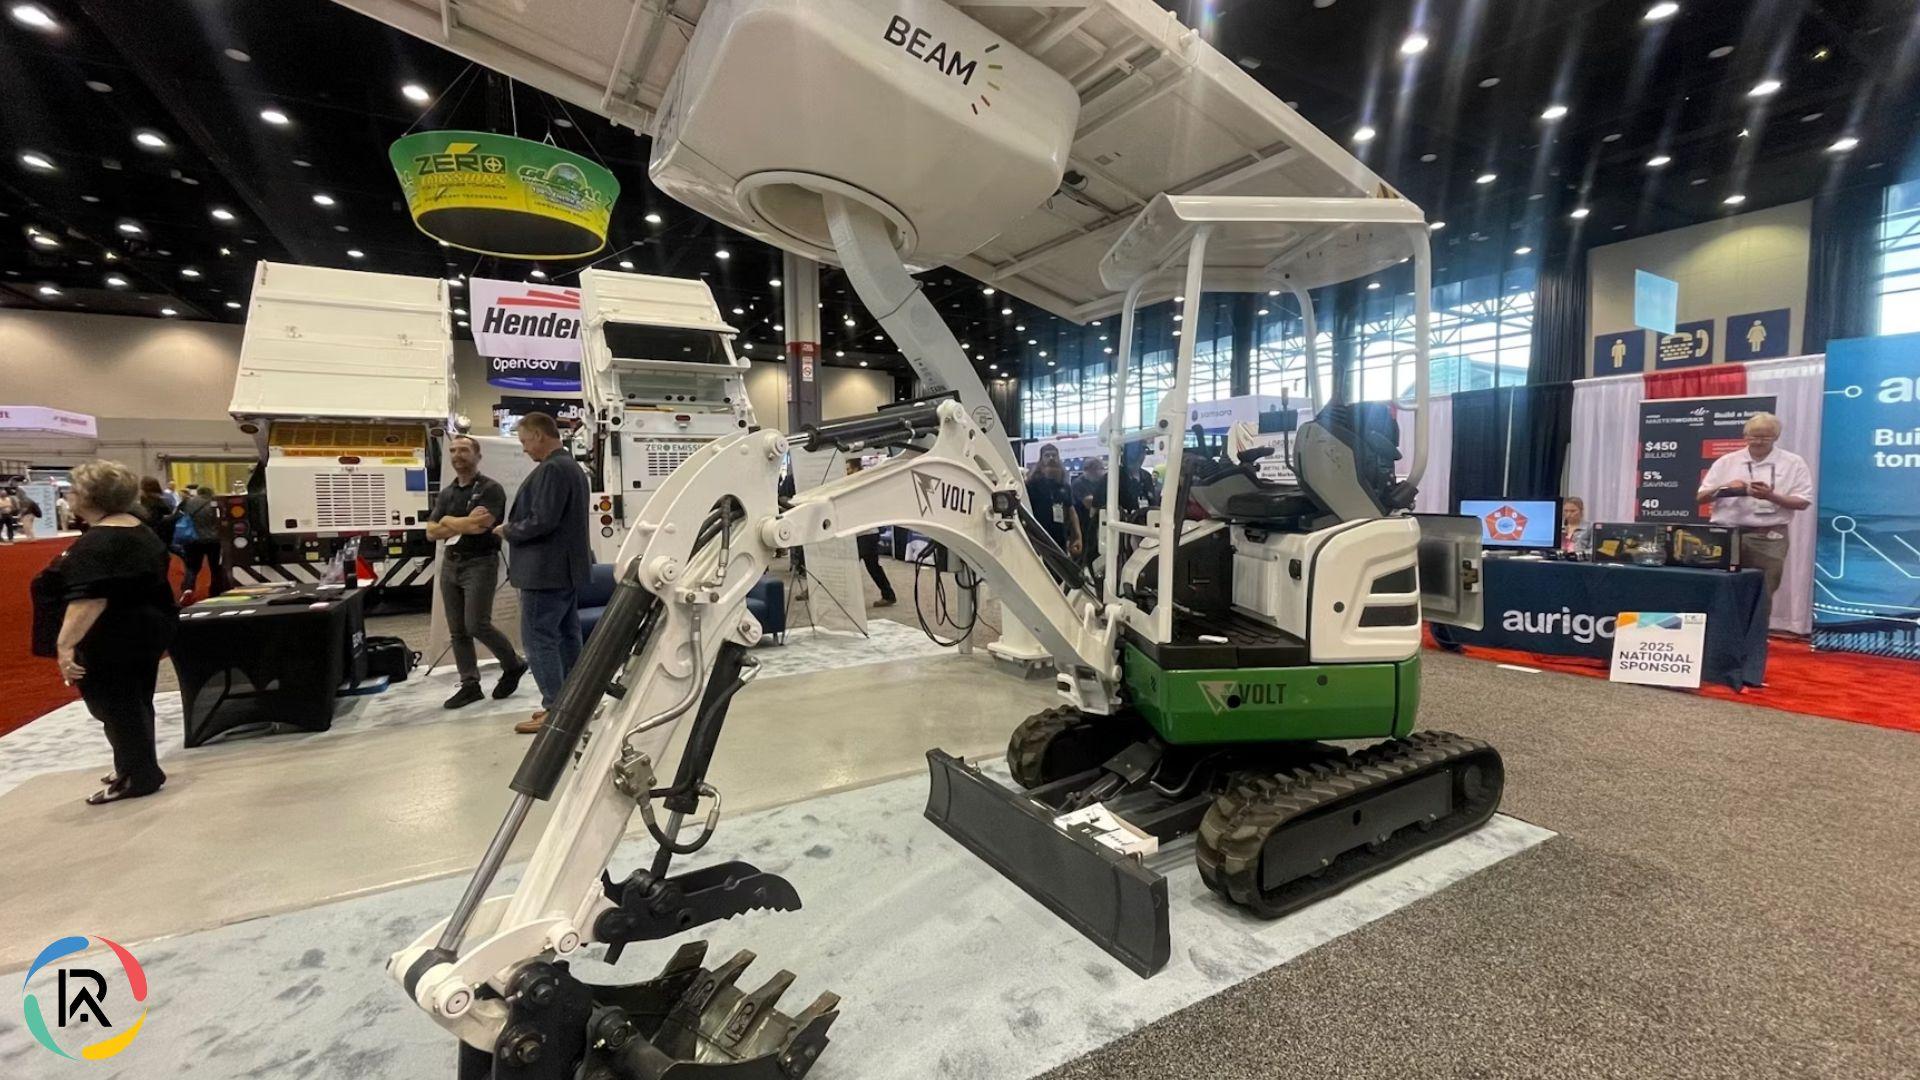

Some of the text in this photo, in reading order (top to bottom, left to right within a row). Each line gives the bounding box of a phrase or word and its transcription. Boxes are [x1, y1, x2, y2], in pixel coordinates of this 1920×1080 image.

[883, 14, 978, 86] BEAM
[493, 357, 558, 373] OpenGov
[1645, 441, 1678, 452] $450
[1643, 471, 1662, 480] 5%
[941, 482, 975, 515] VOLT
[1642, 499, 1659, 509] 40
[1642, 509, 1689, 517] THOUSAND
[1639, 641, 1674, 652] 2025
[1619, 651, 1694, 664] NATIONAL
[1619, 661, 1691, 674] SPONSOR
[1238, 683, 1287, 705] VOLT
